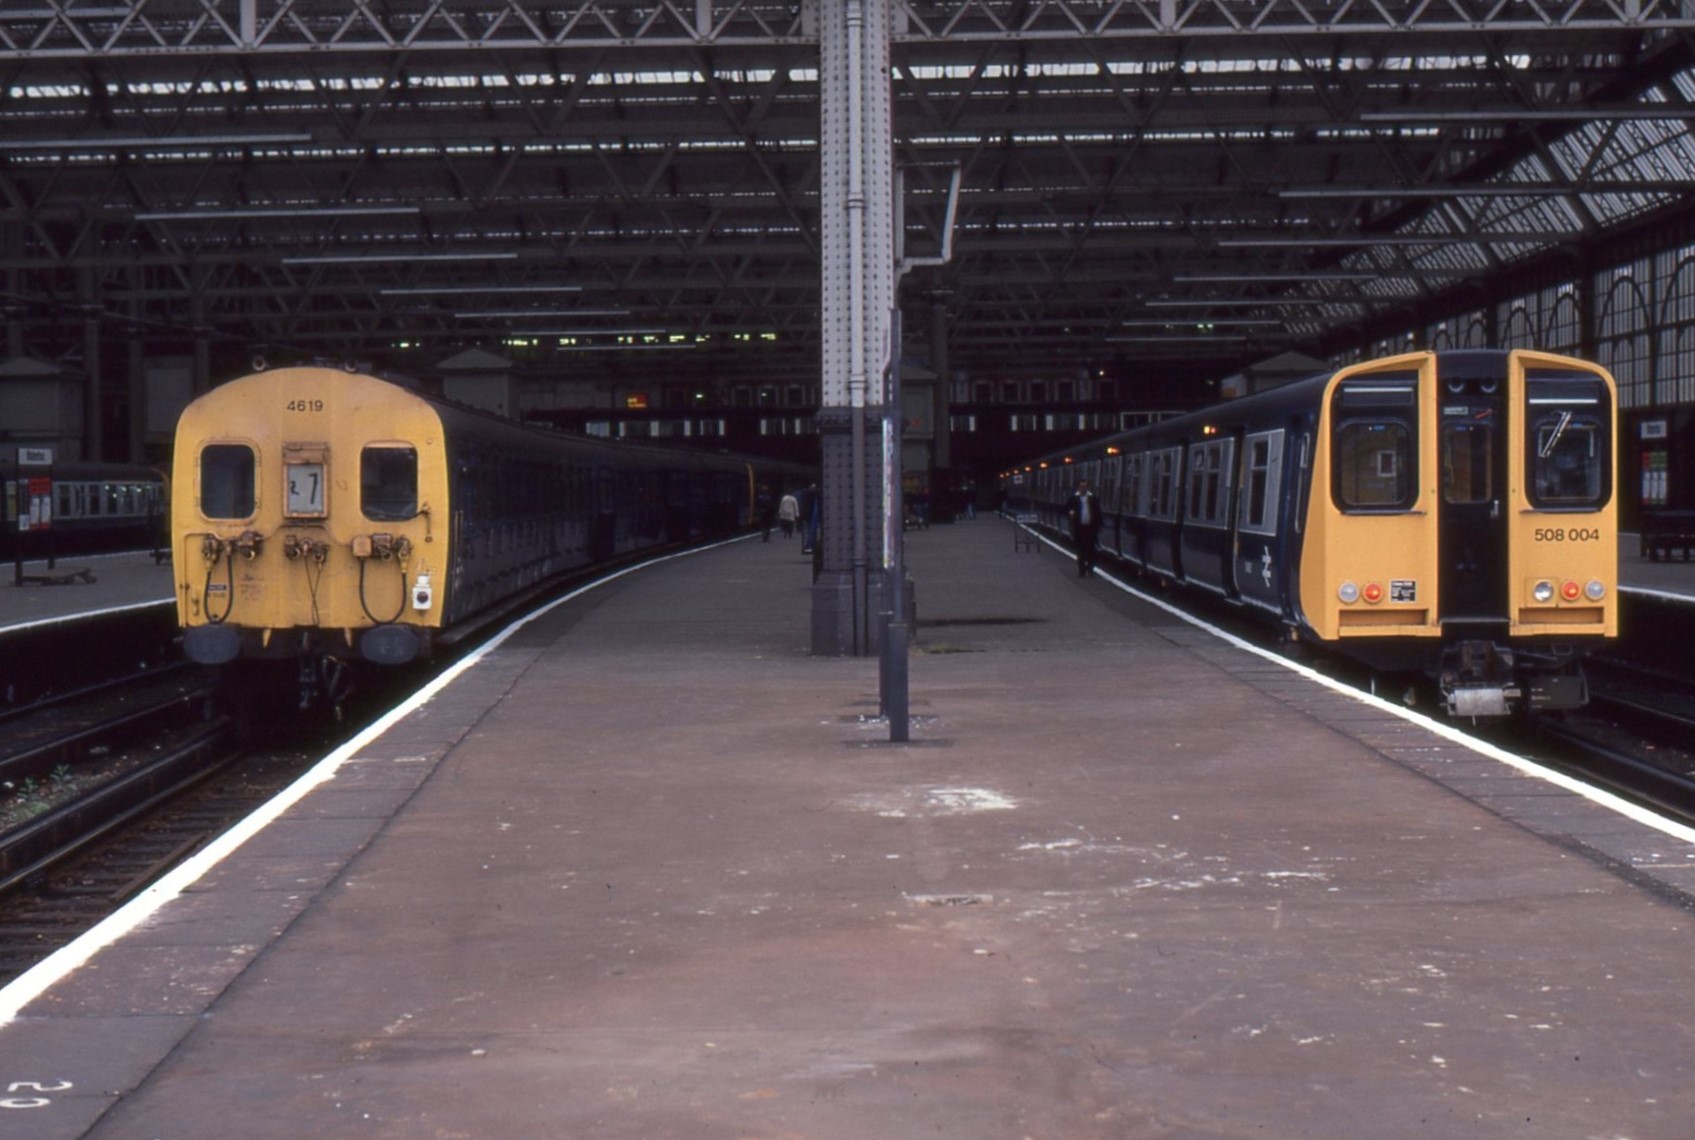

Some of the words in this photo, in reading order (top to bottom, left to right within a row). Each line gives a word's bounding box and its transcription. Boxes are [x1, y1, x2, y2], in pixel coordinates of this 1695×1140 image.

[286, 400, 323, 412] 4619
[1534, 528, 1565, 542] 508
[1568, 528, 1600, 542] 004
